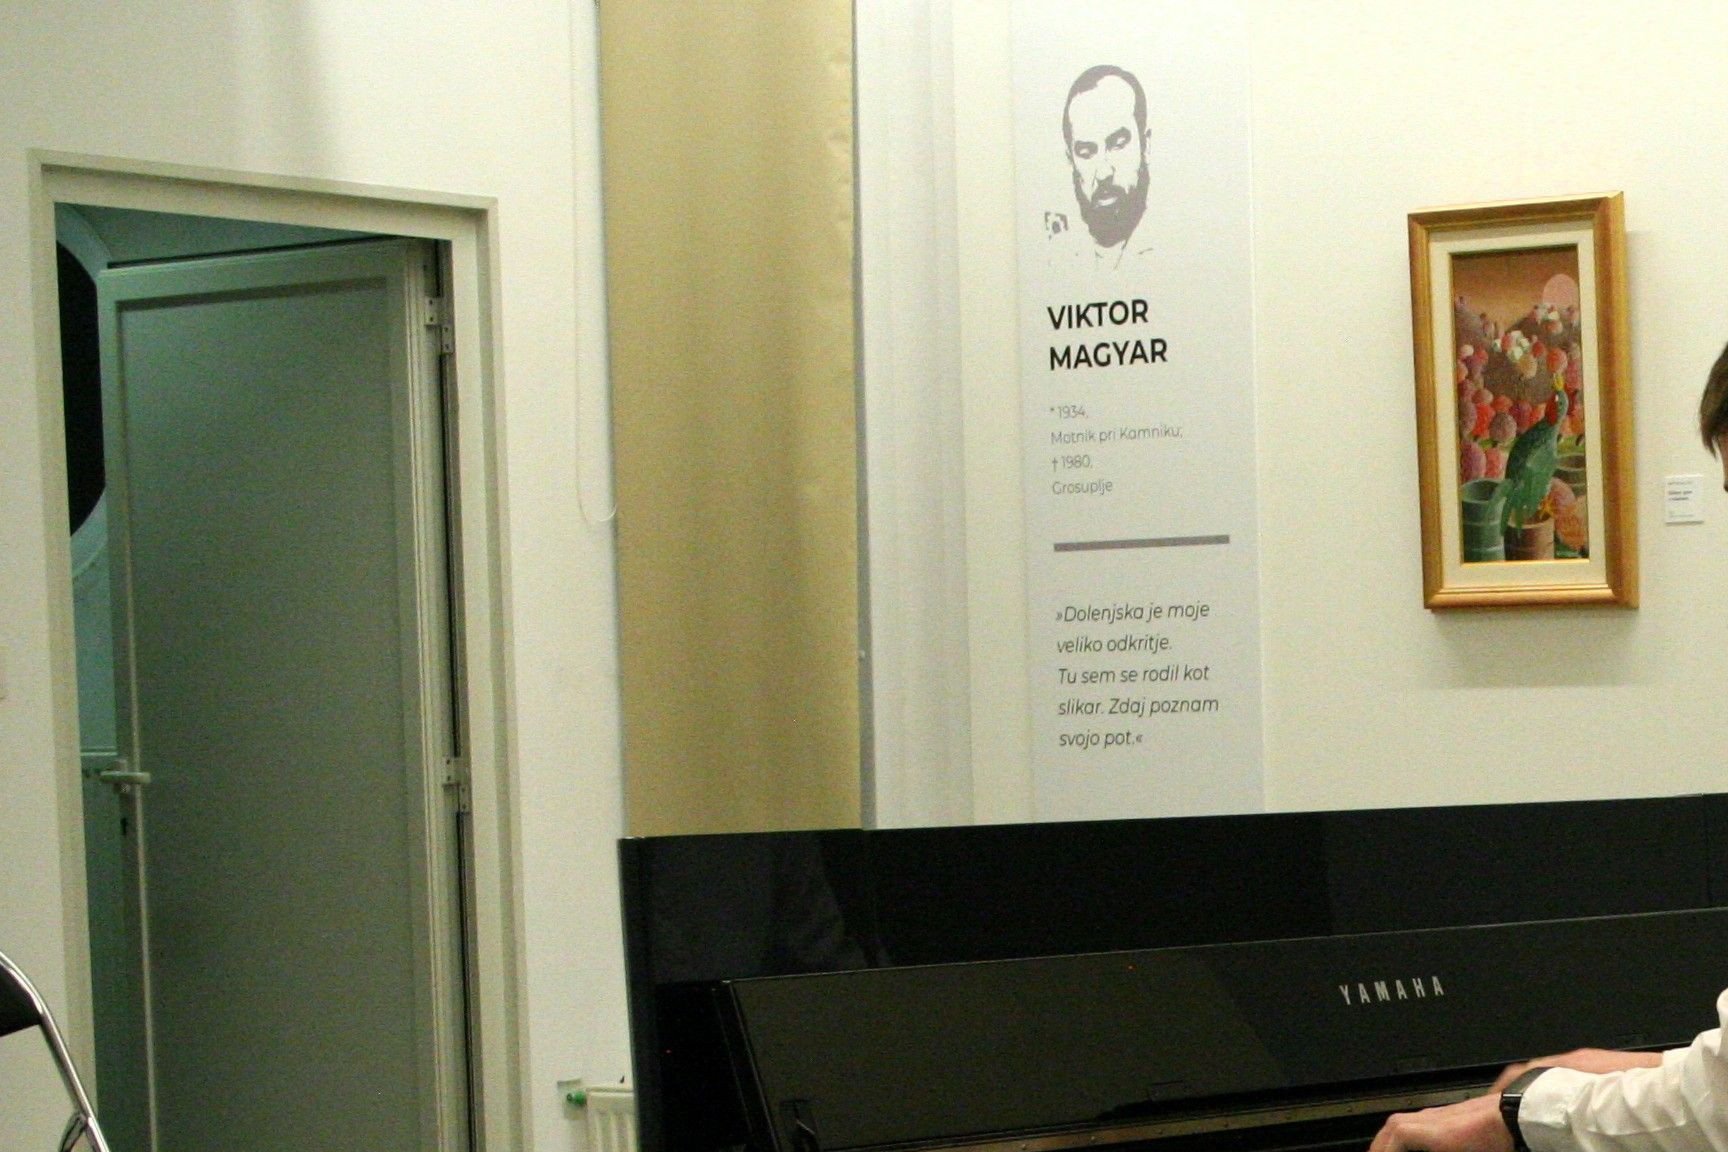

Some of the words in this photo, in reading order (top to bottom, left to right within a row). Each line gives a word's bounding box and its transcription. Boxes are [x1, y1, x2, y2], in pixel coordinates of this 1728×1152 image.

[1047, 299, 1148, 330] VIKTOR
[1050, 338, 1167, 371] MAGYAR
[1145, 602, 1163, 622] je
[1167, 601, 1210, 621] moje
[1057, 636, 1103, 653] veliko
[1106, 634, 1172, 654] odkritje.
[1058, 668, 1077, 684] Tu
[1081, 669, 1116, 684] sem
[1120, 669, 1138, 682] se
[1142, 665, 1179, 682] rodil
[1183, 664, 1210, 681] kot
[1057, 698, 1105, 716] slikar.
[1108, 697, 1146, 717] Zdaj
[1149, 698, 1219, 716] poznam
[1059, 729, 1100, 750] svojo
[1338, 975, 1445, 1006] YAMAHA
